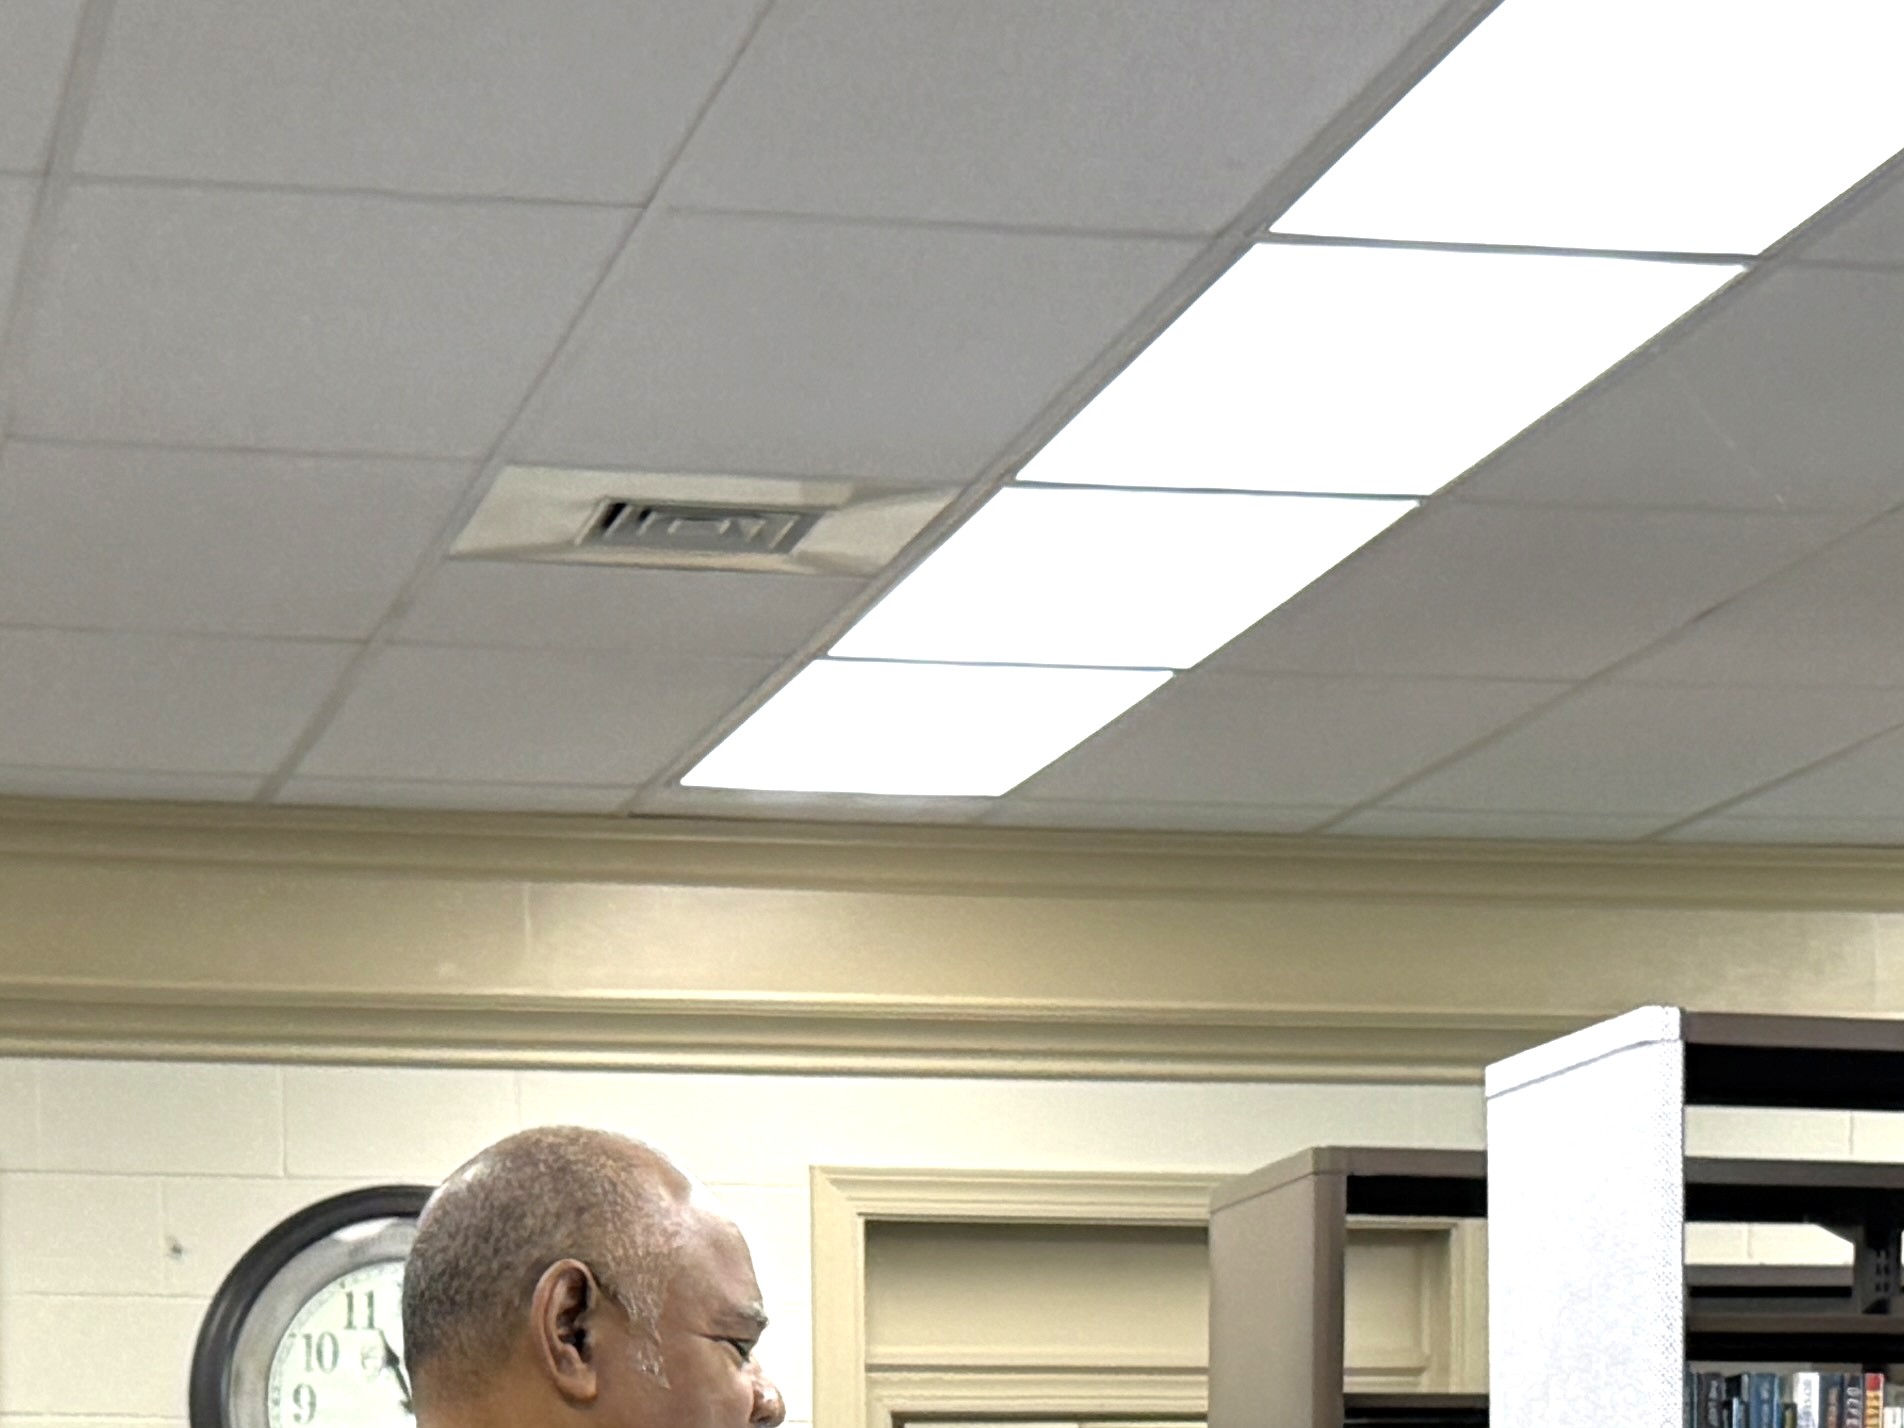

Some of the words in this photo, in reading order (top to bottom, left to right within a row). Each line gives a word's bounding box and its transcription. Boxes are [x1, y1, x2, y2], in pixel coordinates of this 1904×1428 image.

[344, 1291, 376, 1331] 11
[300, 1331, 340, 1375] 10
[292, 1383, 317, 1425] 9
